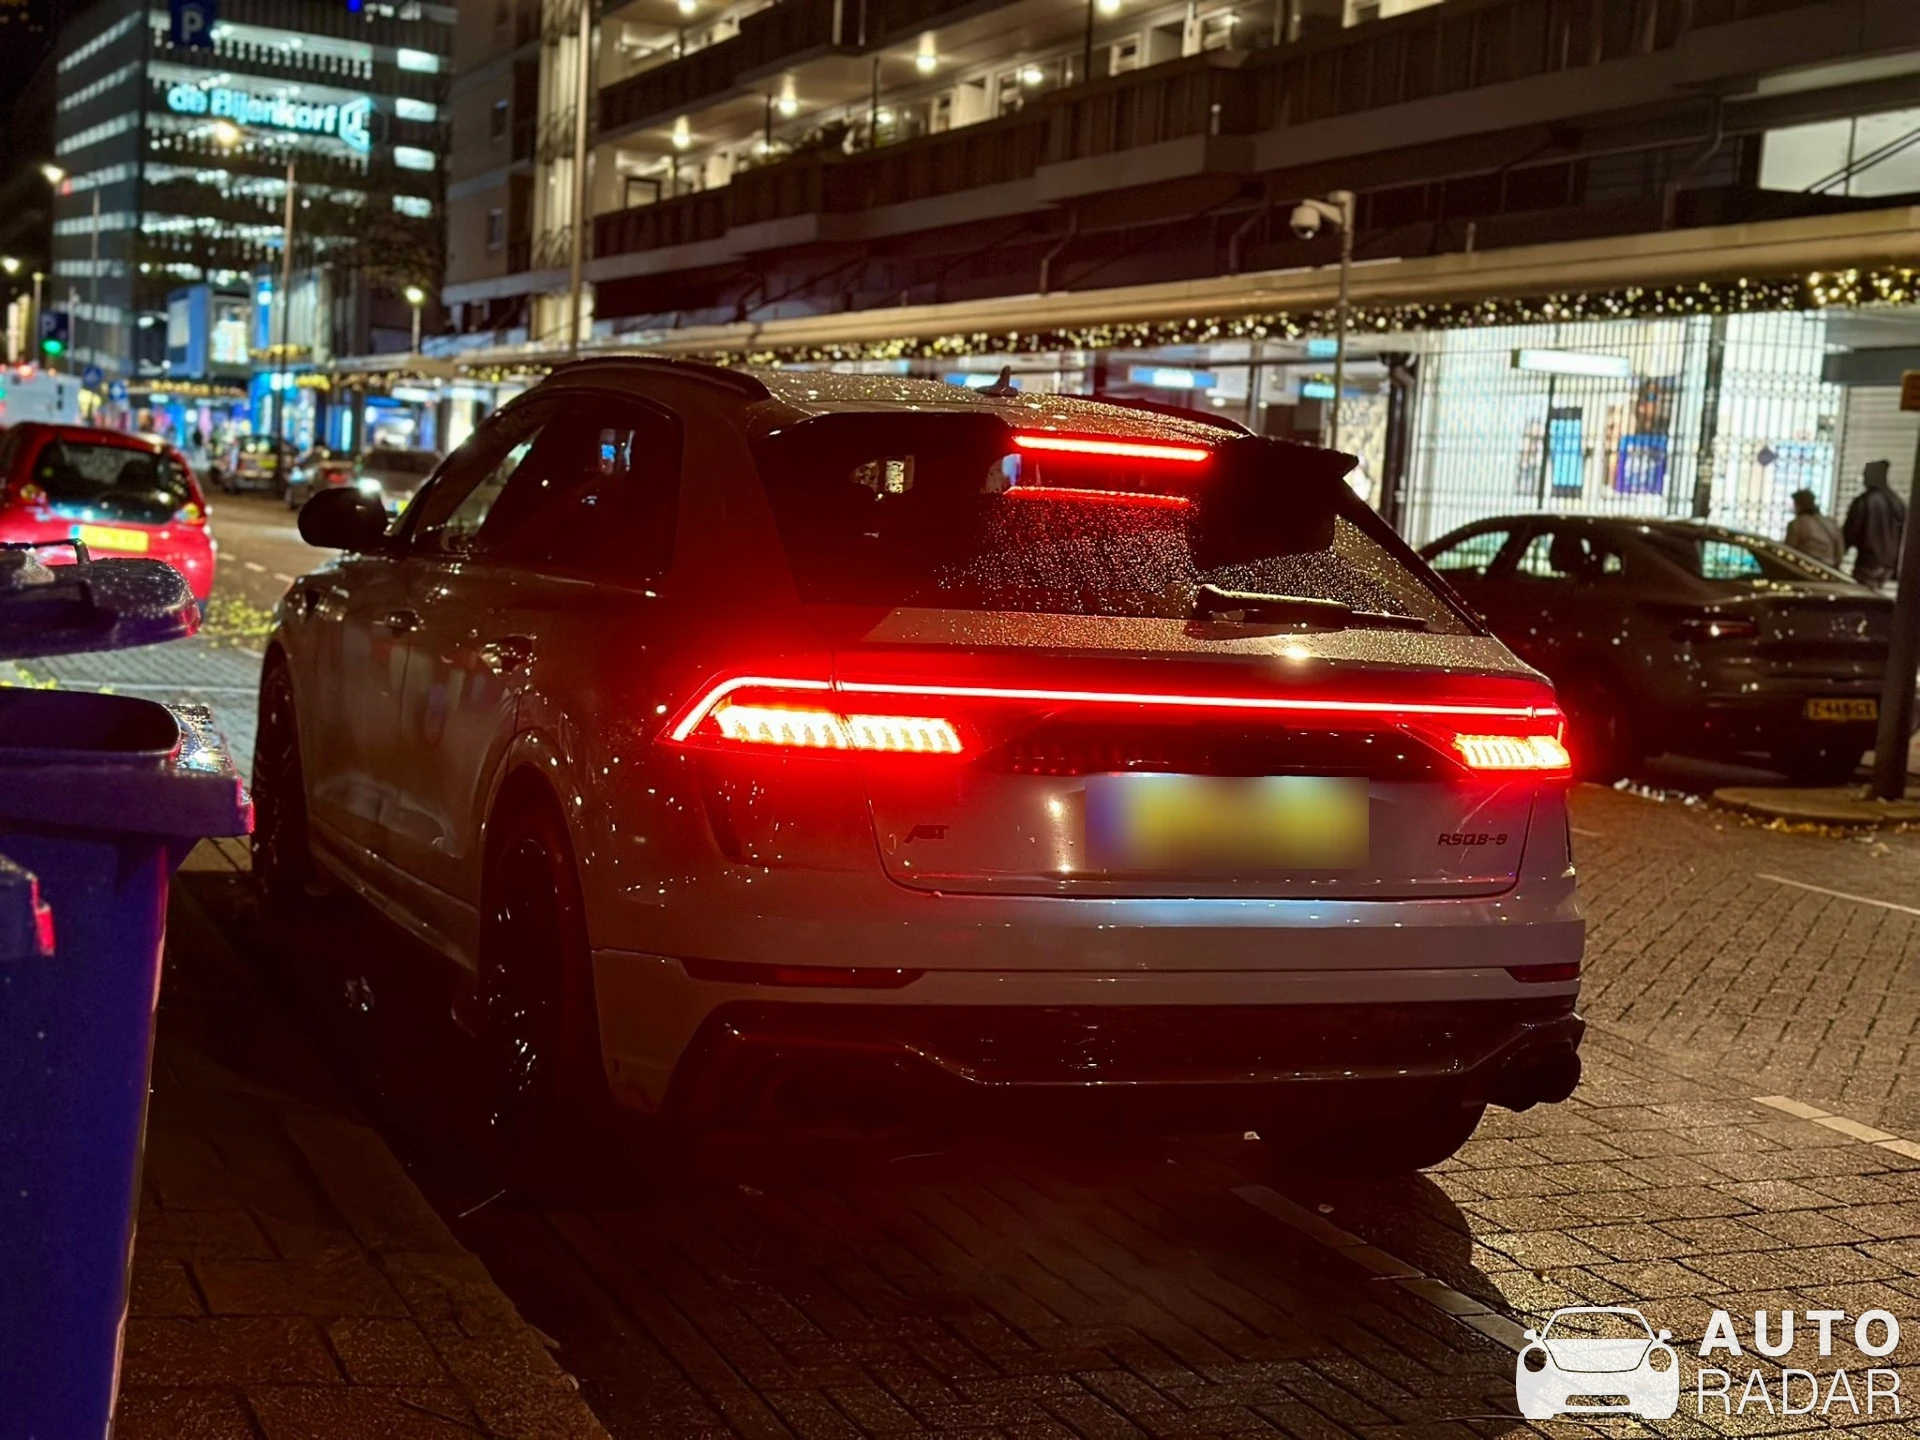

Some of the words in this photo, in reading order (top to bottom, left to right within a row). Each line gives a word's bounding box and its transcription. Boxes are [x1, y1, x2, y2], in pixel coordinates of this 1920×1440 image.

[181, 10, 204, 42] P
[168, 83, 207, 113] de
[211, 88, 338, 133] Bijenkorf
[903, 824, 950, 844] ABT
